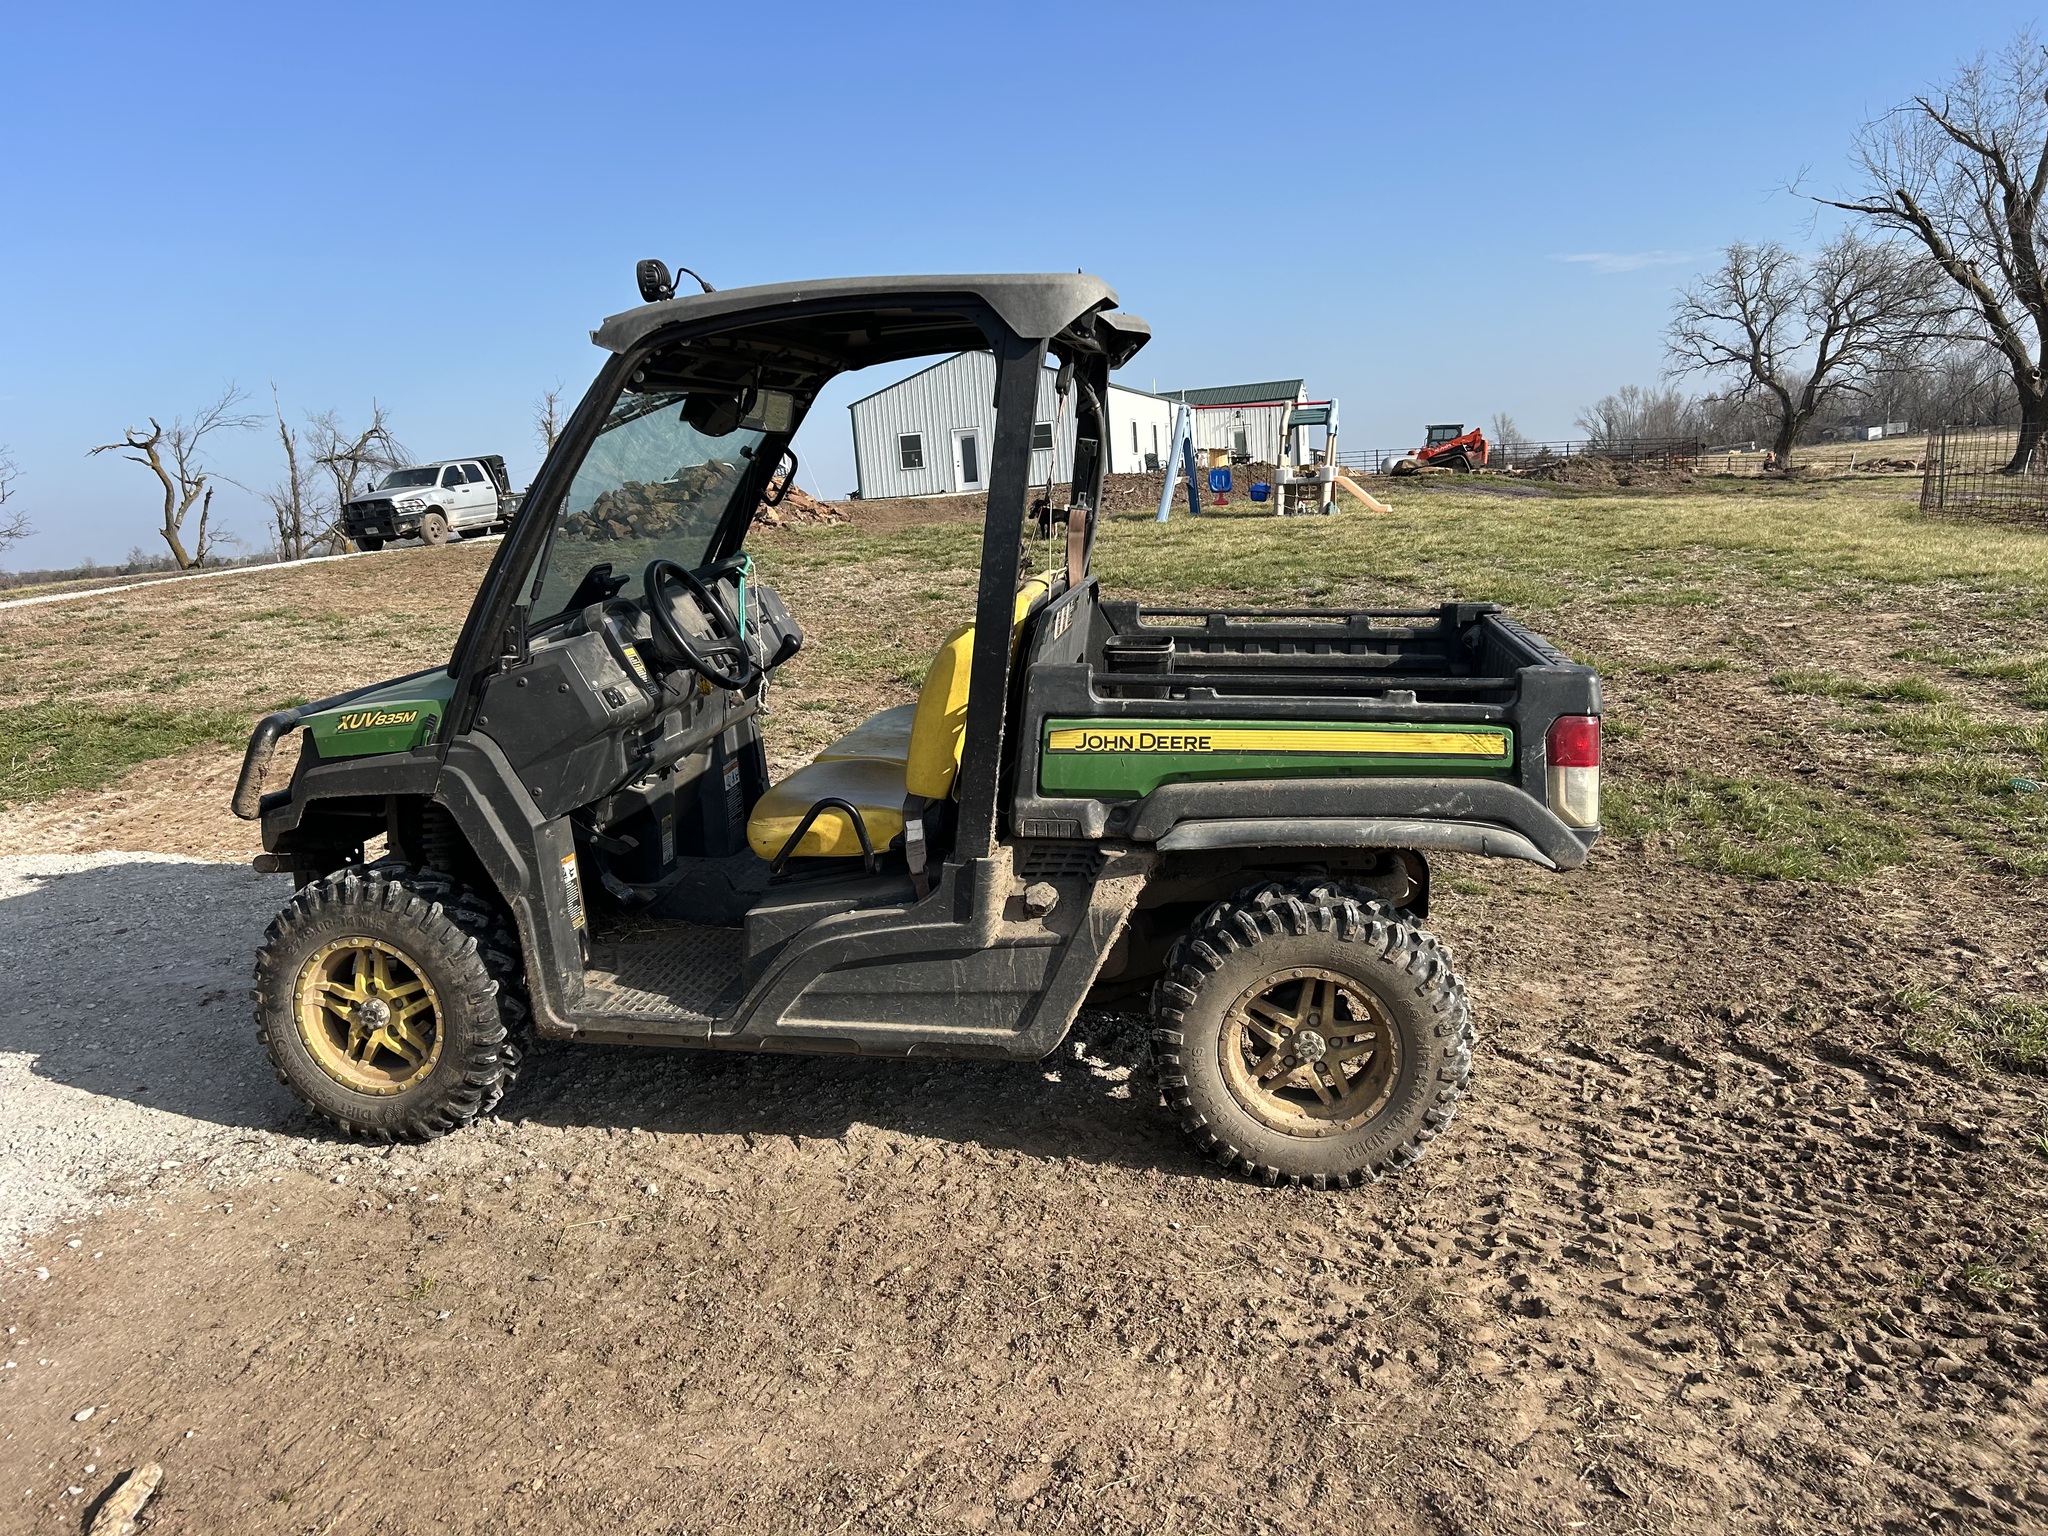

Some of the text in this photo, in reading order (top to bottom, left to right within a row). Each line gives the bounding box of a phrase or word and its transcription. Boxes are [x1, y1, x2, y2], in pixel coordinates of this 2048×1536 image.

[337, 711, 417, 730] XUV835M
[1075, 732, 1211, 749] JOHN DEERE
[338, 1102, 372, 1120] DIRT
